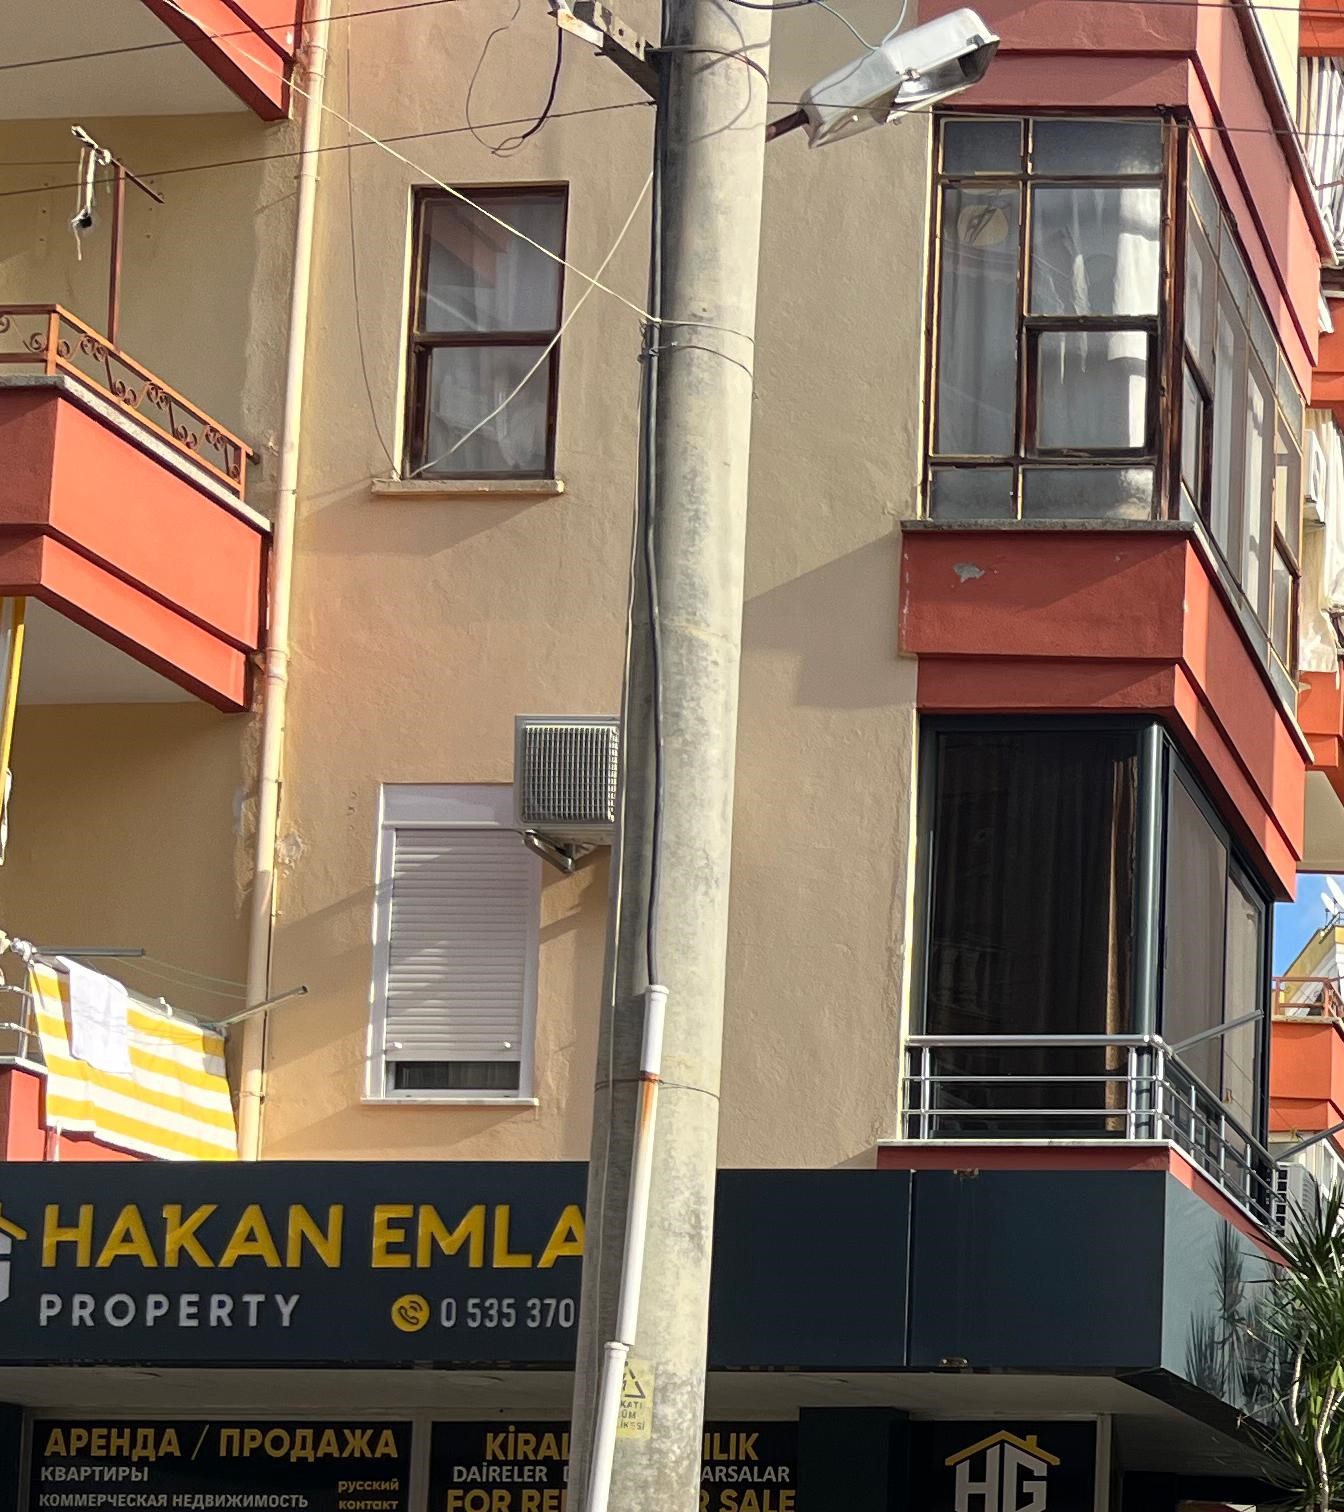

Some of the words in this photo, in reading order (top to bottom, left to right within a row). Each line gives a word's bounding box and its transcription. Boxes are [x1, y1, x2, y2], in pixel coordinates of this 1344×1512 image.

[41, 1204, 344, 1268] HAKAN
[370, 1204, 584, 1268] EMLA
[39, 1293, 301, 1328] PROPERTY
[441, 1298, 457, 1328] 0
[466, 1297, 517, 1328] 535
[526, 1297, 576, 1329] 370
[44, 1428, 182, 1462] АРЕНДА
[219, 1428, 399, 1462] ПРОДАЖА
[485, 1425, 570, 1461] KİRA
[703, 1432, 760, 1461] ILIK
[40, 1466, 149, 1482] КВАРТИРЫ
[452, 1462, 548, 1482] DAİRELER
[700, 1466, 790, 1482] ARSALAR
[337, 1478, 399, 1493] русский
[39, 1494, 167, 1508] КОММЕРЧЕСКАЯ
[172, 1494, 309, 1510] НЕДВИЖИМОСТЬ
[338, 1499, 399, 1511] контакт
